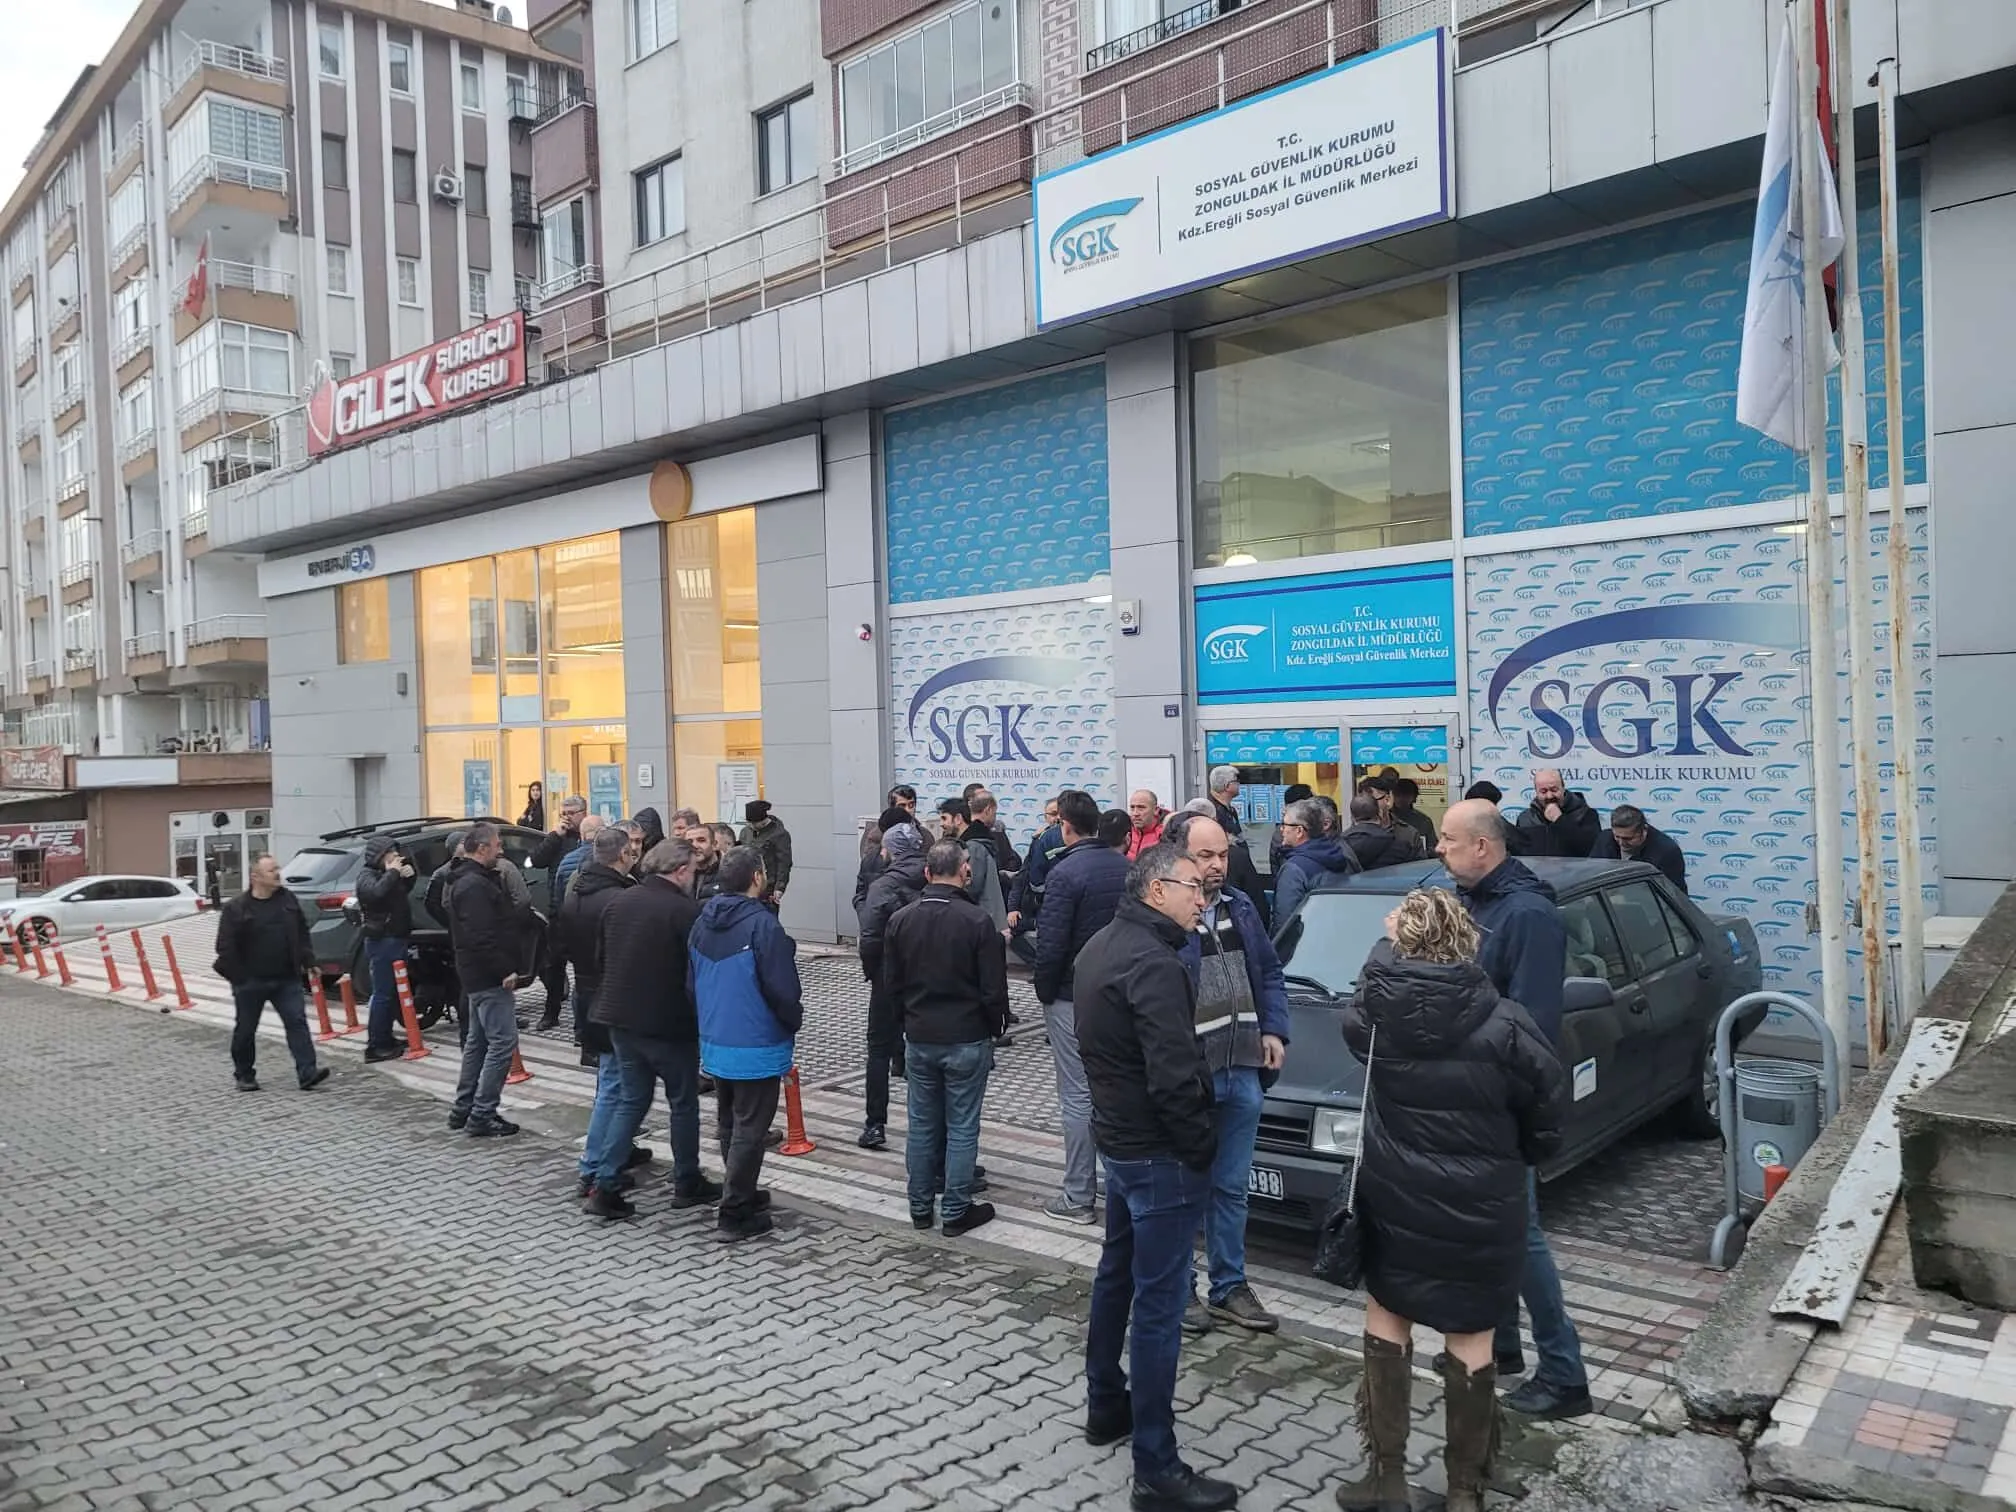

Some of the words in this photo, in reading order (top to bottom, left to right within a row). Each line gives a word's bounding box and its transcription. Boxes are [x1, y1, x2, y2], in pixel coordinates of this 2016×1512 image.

[1277, 133, 1302, 149] T.C.
[1195, 172, 1246, 196] SOSYAL
[1251, 144, 1323, 179] GÜVENLİK
[1328, 120, 1394, 152] KURUMU
[1195, 181, 1278, 216] ZONGULDAK
[1283, 175, 1296, 189] İL
[1300, 141, 1396, 184] MÜDÜRLÜĞÜ
[1179, 214, 1242, 240] Kdz.Ereğli
[1246, 198, 1289, 221] Sosyal
[1295, 180, 1355, 205] Güvenlik
[1360, 157, 1418, 185] Merkezi
[1062, 222, 1119, 266] SGK
[436, 317, 516, 373] SÜRÜCÜ
[442, 359, 509, 402] KURSU
[1353, 606, 1373, 617] T.C.
[1291, 638, 1355, 651] ZONGULDAK
[1357, 634, 1368, 647] İL
[1372, 628, 1442, 646] MÜDÜRLÜĞÜ
[1292, 624, 1330, 637] SOSYAL
[1332, 619, 1387, 634] GÜVENLİK
[1390, 616, 1440, 630] KURUMU
[1210, 639, 1248, 661] SGK
[1286, 655, 1306, 666] Kdz.
[1308, 652, 1334, 667] Ereğli
[1335, 651, 1364, 665] Sosyal
[1366, 648, 1407, 662] Güvenlik
[1410, 646, 1449, 659] Merkezi
[1527, 672, 1754, 759] SGK
[929, 704, 1039, 763] SGK
[929, 769, 956, 778] SOSYAL
[959, 767, 1000, 778] GÜVENLİK
[1003, 769, 1040, 778] KURUMU
[1588, 765, 1672, 781] GÜVENLİK
[1678, 767, 1756, 781] KURUMU
[1249, 1169, 1280, 1195] 098
